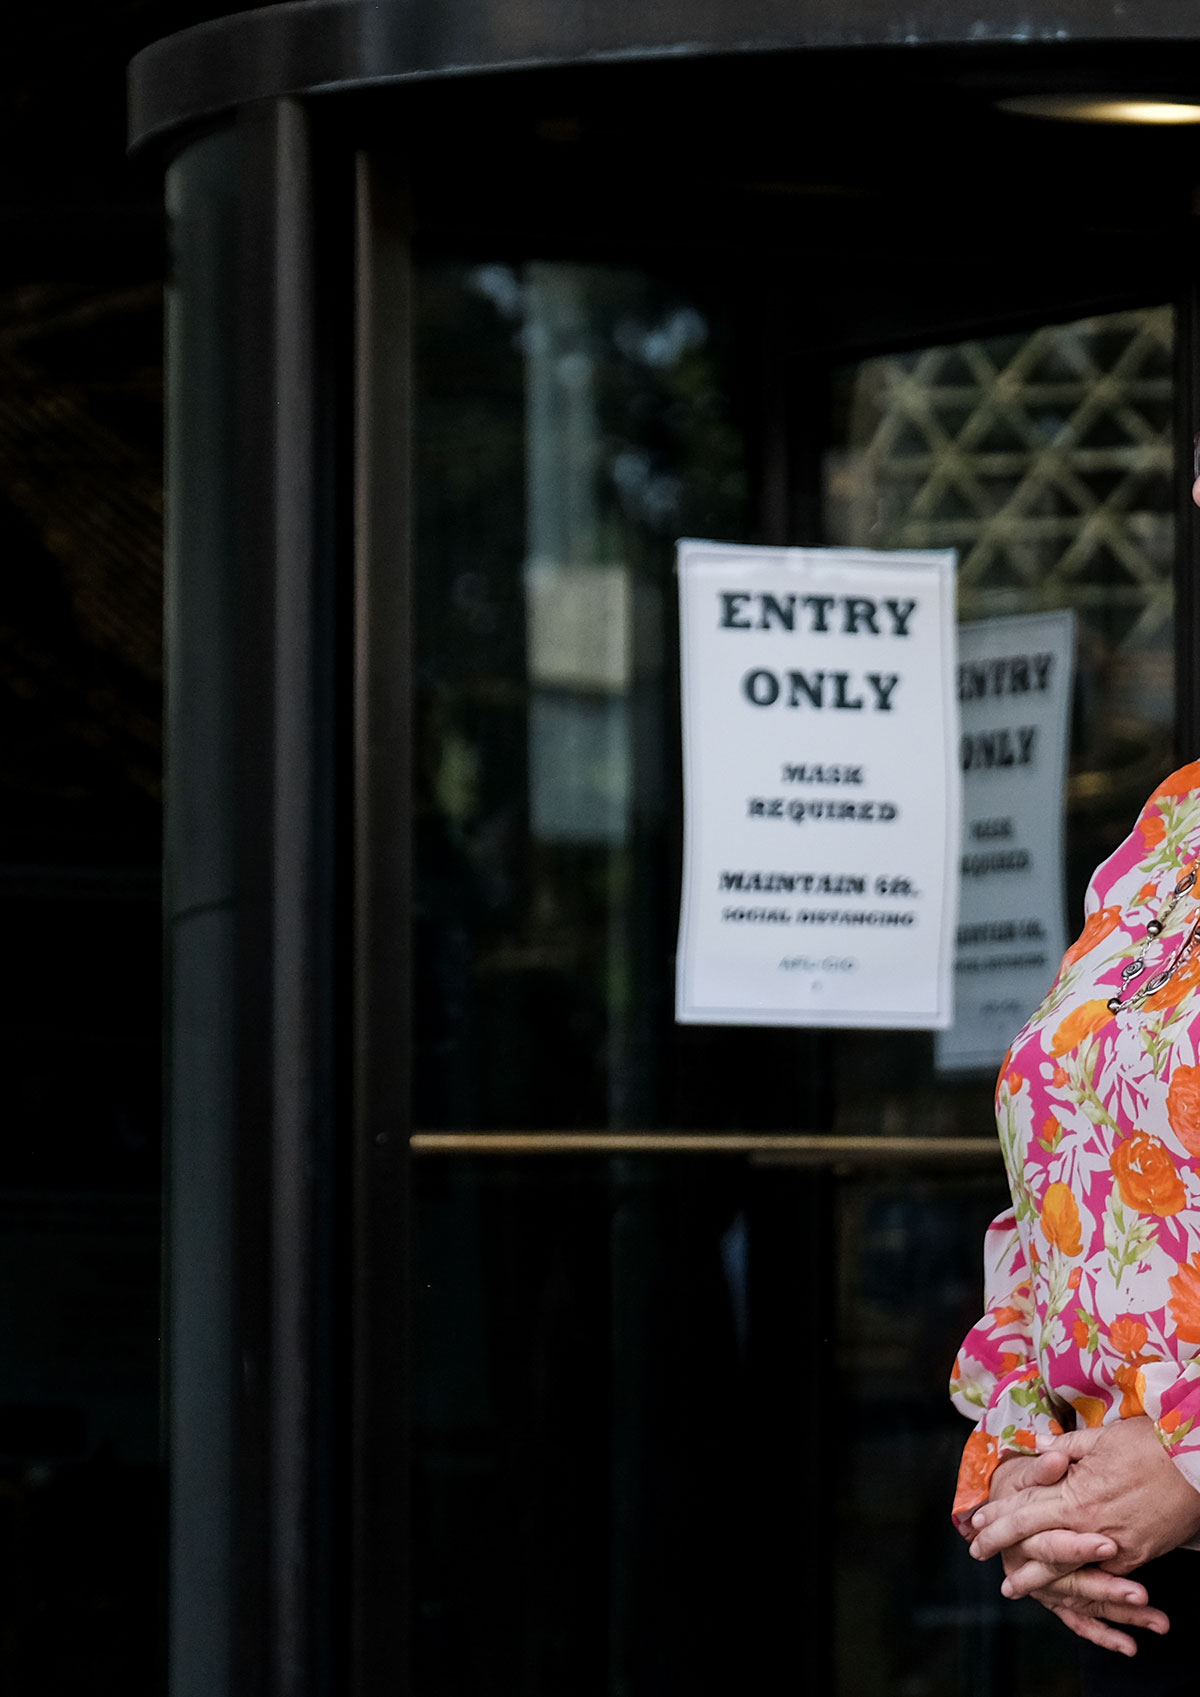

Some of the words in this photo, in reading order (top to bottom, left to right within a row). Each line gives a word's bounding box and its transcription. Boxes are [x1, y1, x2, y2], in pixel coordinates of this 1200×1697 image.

[717, 590, 917, 636] ENTRY
[743, 667, 899, 711] ONLY
[960, 653, 1054, 699] NTRY
[781, 764, 865, 784] MASK
[747, 799, 898, 826] REQUIRED
[717, 871, 866, 895] MAINTAIN
[722, 906, 792, 924] SOCIAL
[796, 909, 916, 927] DISTANCING
